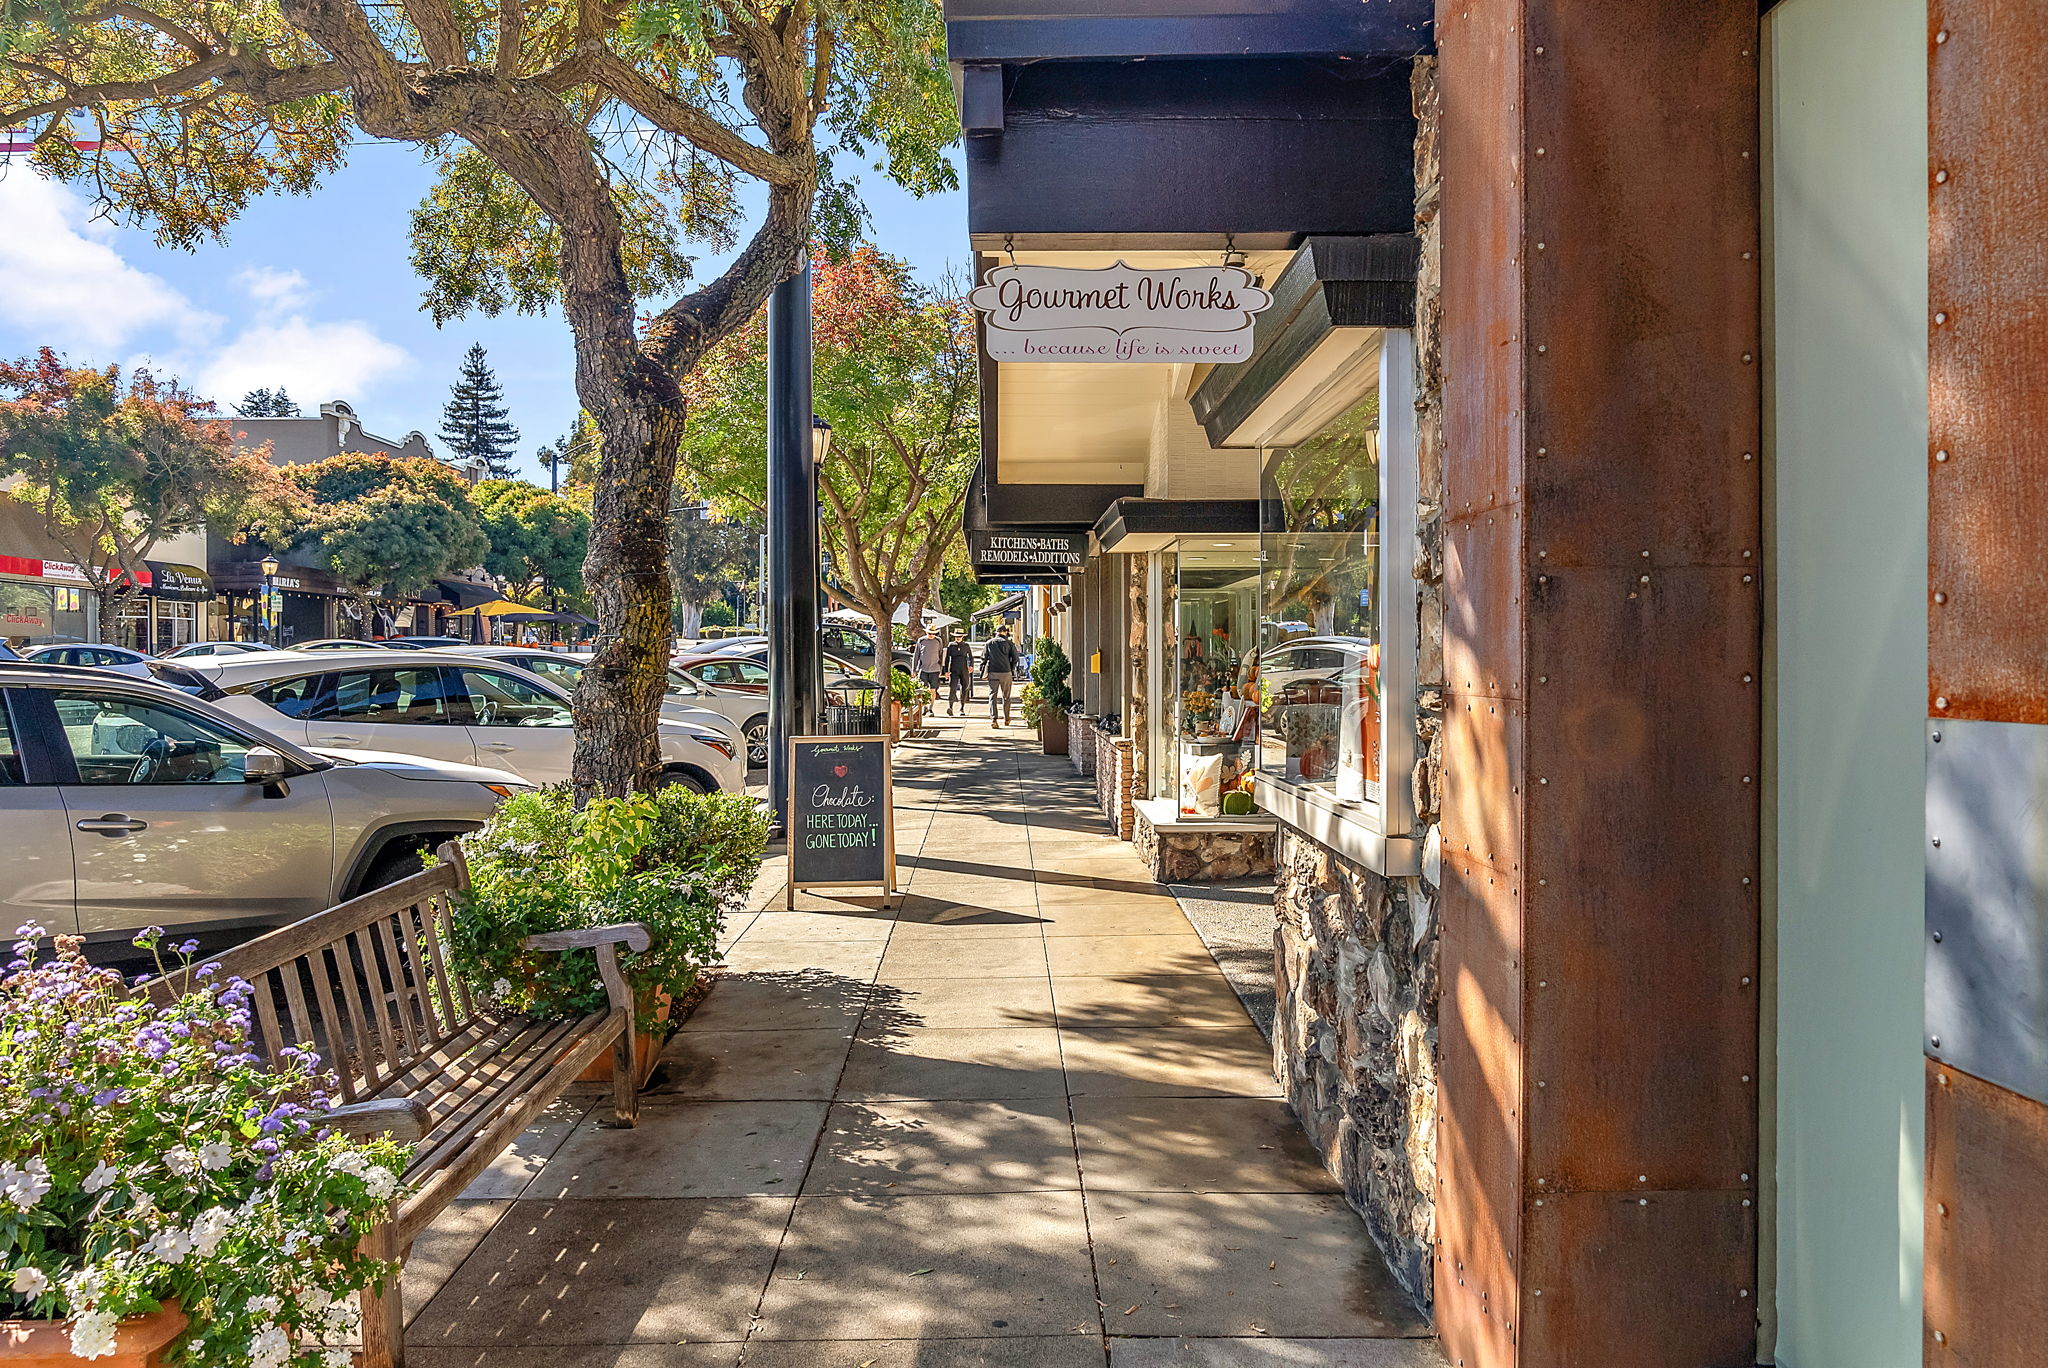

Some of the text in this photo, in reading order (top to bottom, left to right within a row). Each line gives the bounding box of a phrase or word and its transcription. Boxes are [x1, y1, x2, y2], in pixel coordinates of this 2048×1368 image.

[999, 277, 1240, 322] Gourmet Works
[1024, 338, 1110, 356] because
[1115, 338, 1149, 360] life
[1154, 339, 1175, 356] is
[1179, 338, 1244, 356] sweet
[44, 562, 75, 574] ClickAway
[161, 570, 175, 583] La
[6, 614, 43, 626] ClickAway
[806, 814, 835, 829] HERE
[805, 833, 836, 849] GONE
